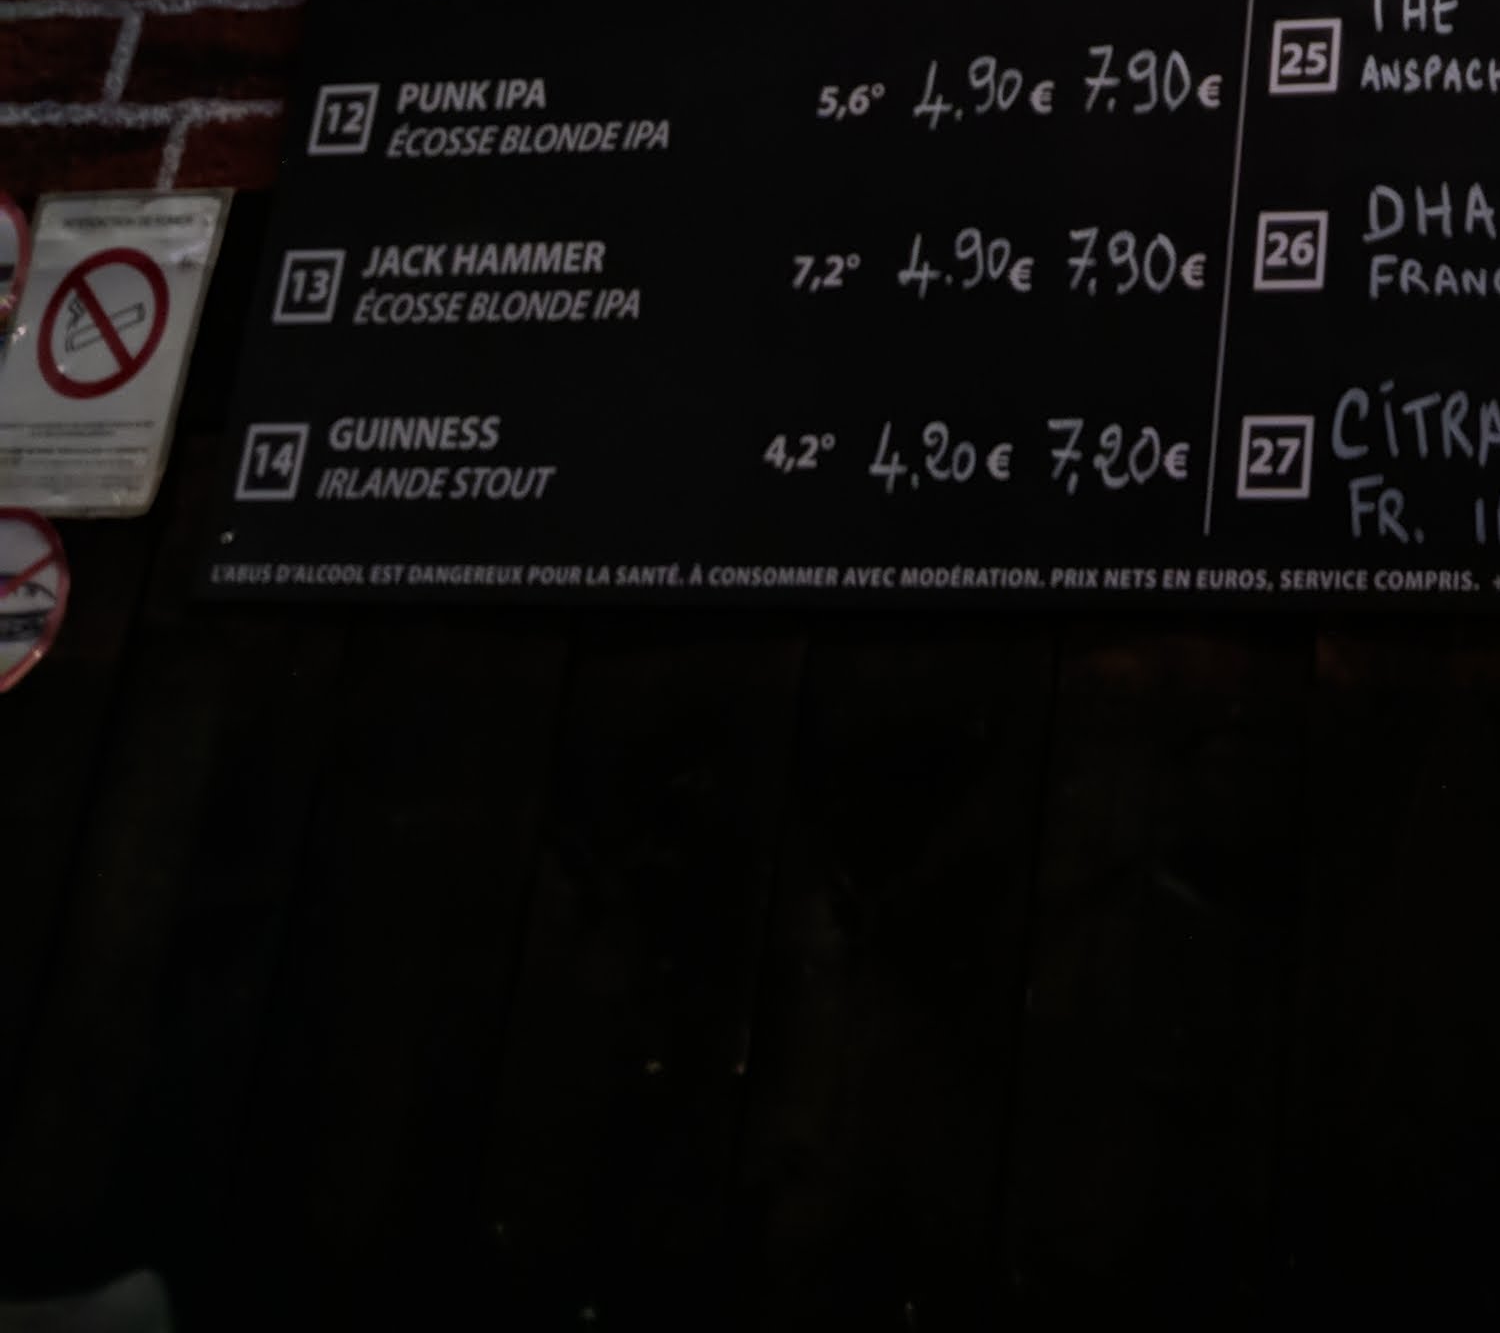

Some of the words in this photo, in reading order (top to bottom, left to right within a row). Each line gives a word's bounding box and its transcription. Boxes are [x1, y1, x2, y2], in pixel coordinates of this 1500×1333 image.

[395, 79, 492, 115] PUNK
[493, 77, 547, 111] IPA
[385, 122, 500, 159] ÉCOSSE
[497, 120, 624, 156] BLONDE
[621, 118, 671, 151] IPA
[360, 243, 449, 279] JACK
[450, 239, 607, 276] HAMMER
[1264, 230, 1320, 268] 26
[352, 287, 468, 326] ÉCOSSE
[465, 288, 594, 323] BLONDE
[591, 287, 642, 321] IPA
[327, 414, 502, 452] GUINNESS
[316, 465, 451, 500] IRLANDE
[448, 465, 558, 500] STOUT
[1349, 473, 1425, 544] FR.
[209, 562, 273, 586] L'ABUS
[273, 562, 366, 586] D'ALCOOL
[367, 563, 407, 585] EST
[405, 563, 525, 586] DANGEREUX
[525, 564, 583, 587] POUR
[584, 565, 612, 587] LA
[614, 561, 685, 588] SANTÉ.
[687, 561, 704, 587] À
[706, 564, 840, 588] CONSOMMER
[840, 565, 897, 589] AVEC
[898, 563, 1047, 589] MODÉRATION.
[1048, 566, 1100, 589] PRIX
[1102, 567, 1158, 590] NETS
[1161, 567, 1192, 591] EN
[1194, 567, 1274, 593] EUROS,
[1279, 568, 1369, 592] SERVICE
[1372, 568, 1481, 593] COMPRIS.
